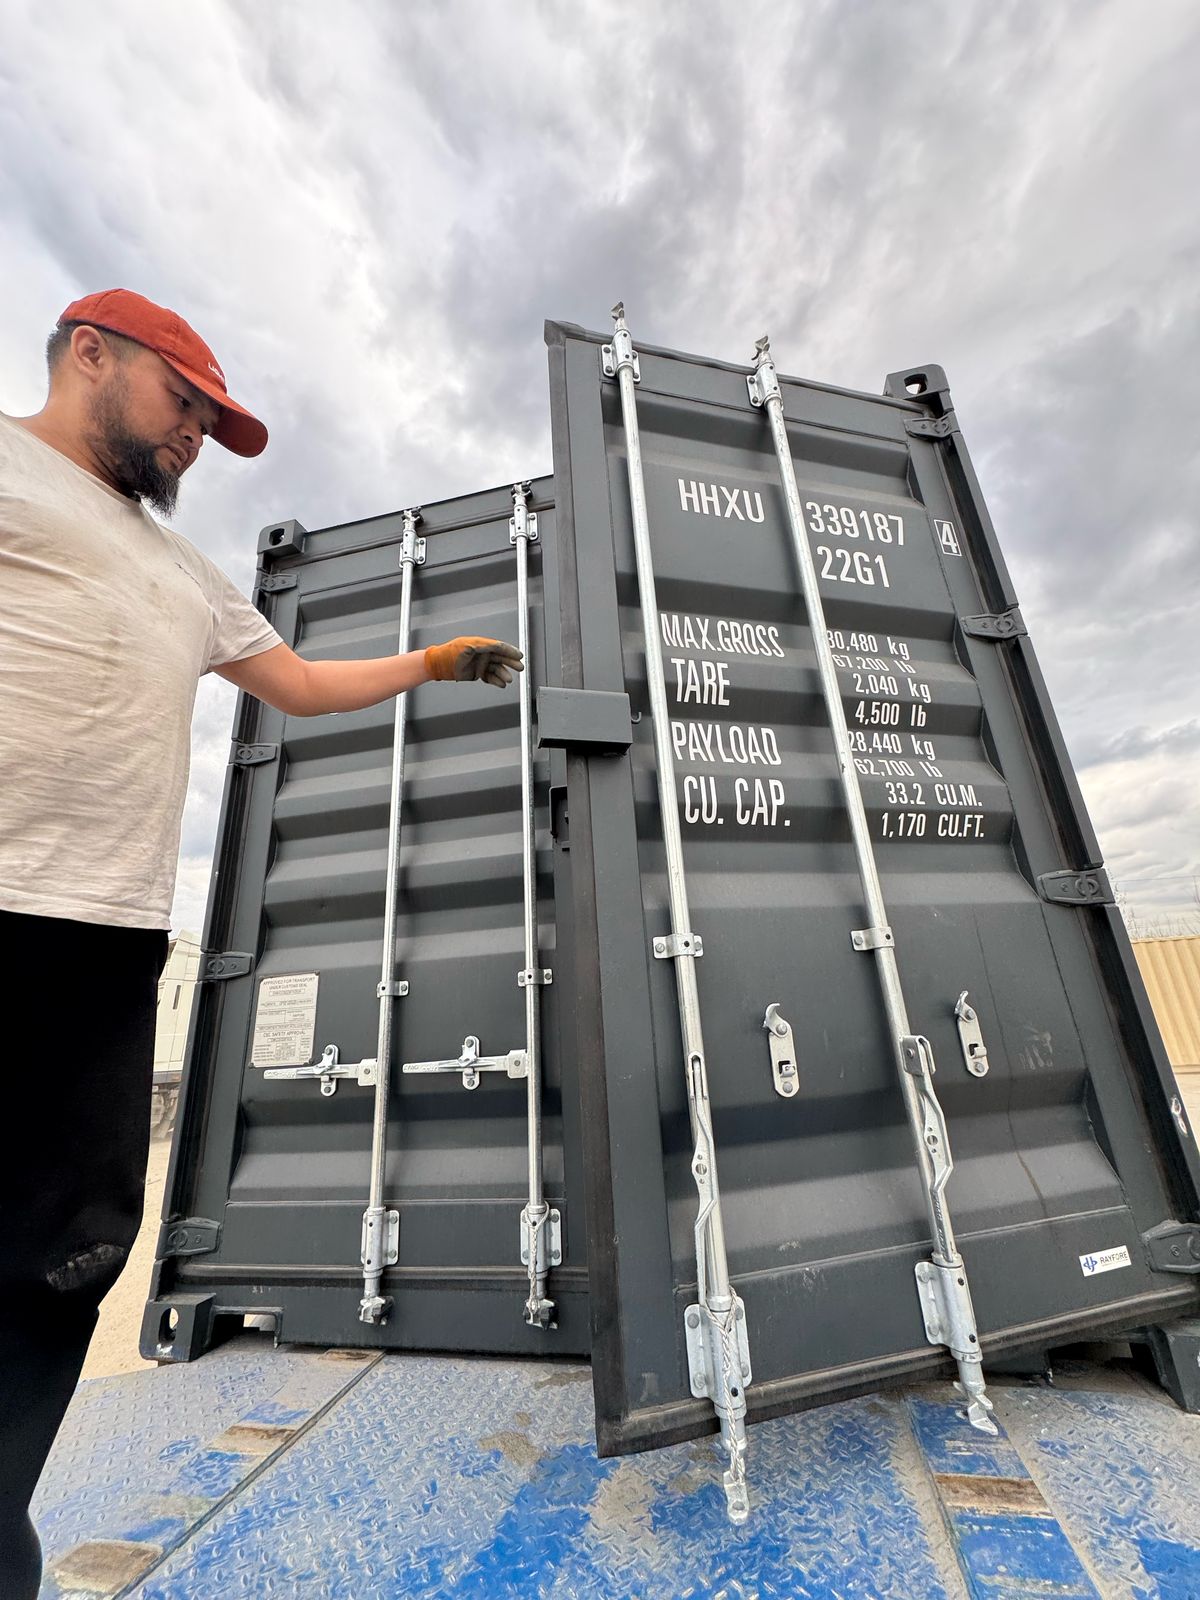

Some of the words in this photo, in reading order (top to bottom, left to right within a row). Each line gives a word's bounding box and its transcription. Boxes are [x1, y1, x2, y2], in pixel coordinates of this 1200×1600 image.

[678, 478, 764, 523] HHXU
[806, 501, 904, 546] 339187
[942, 523, 958, 554] 4
[817, 546, 889, 588] 22G1
[660, 613, 785, 658] MAX.GROSS
[887, 636, 910, 661] kg
[671, 658, 730, 706] TARE
[853, 673, 898, 696] 2,040
[908, 677, 931, 703] kg
[831, 654, 889, 672] 67,200
[893, 660, 916, 674] lb
[854, 700, 900, 726] 4,500
[910, 705, 926, 727] lb
[671, 721, 782, 765] PAYLOAD
[911, 734, 936, 761] kg
[853, 759, 915, 777] 62,700
[919, 761, 943, 778] lb
[683, 775, 724, 825] CU.
[735, 778, 791, 827] CAP.
[885, 782, 926, 805] 33.2
[934, 783, 983, 806] CU.M.
[881, 812, 926, 837] 1,170
[937, 814, 984, 837] CU.FT.
[1100, 1250, 1128, 1264] RAYFORE
